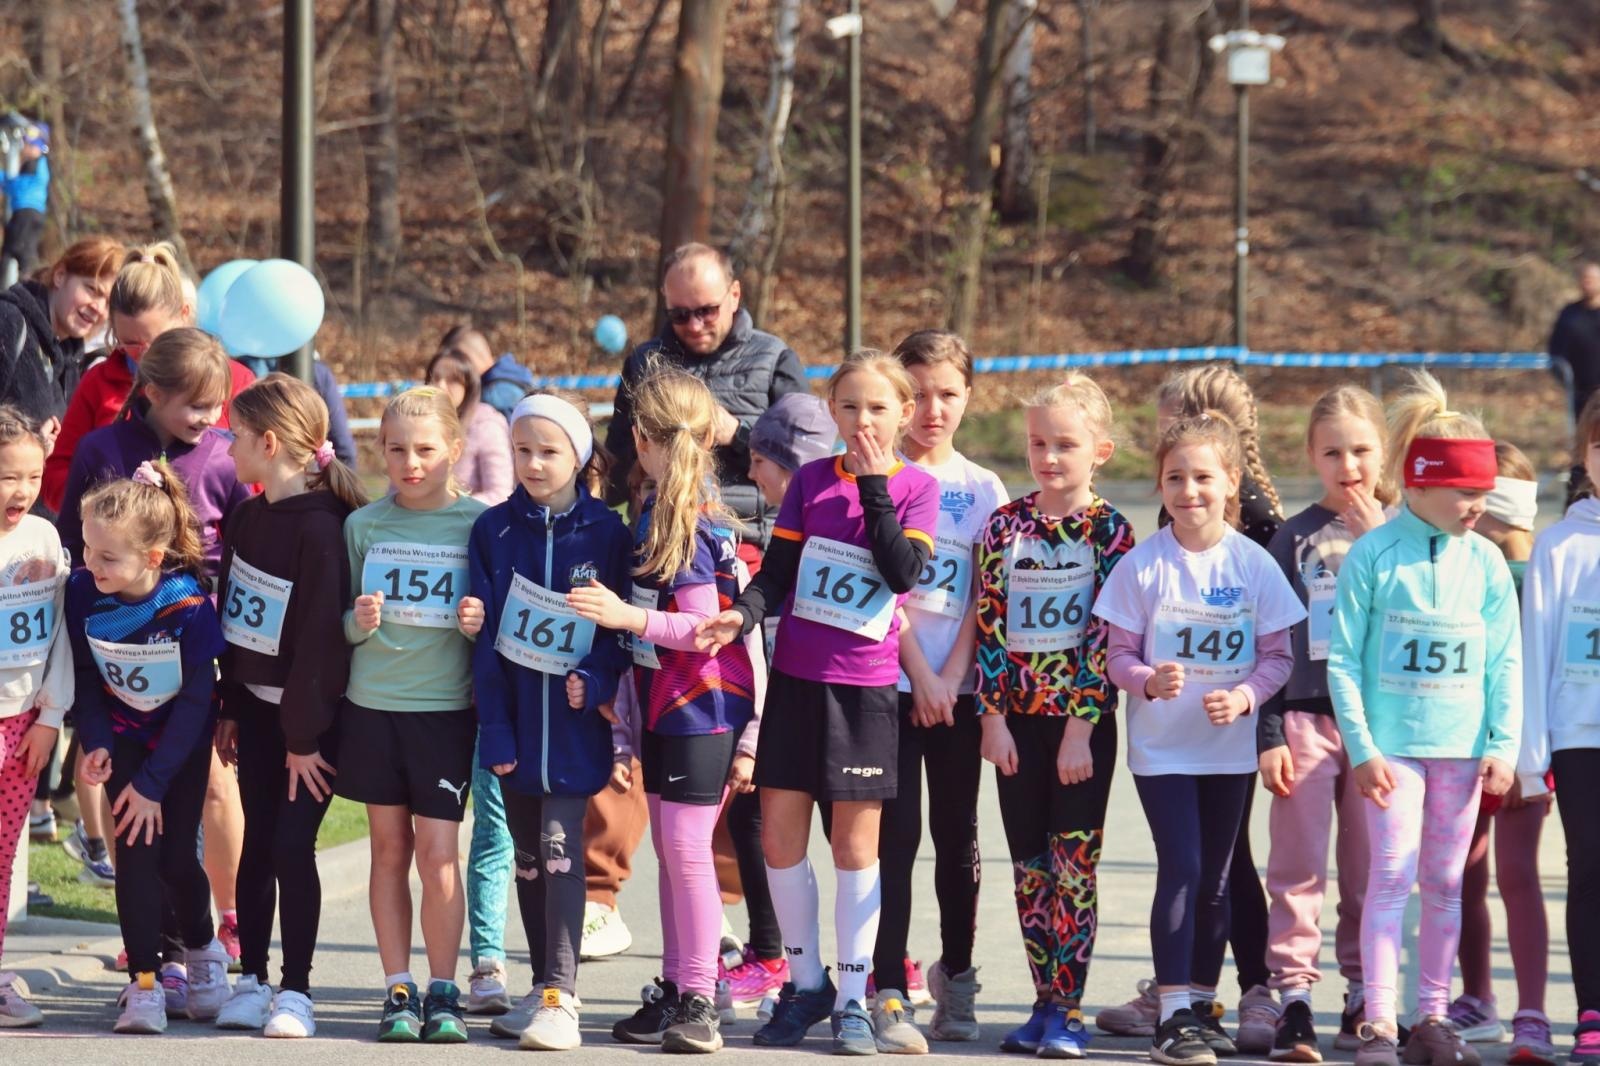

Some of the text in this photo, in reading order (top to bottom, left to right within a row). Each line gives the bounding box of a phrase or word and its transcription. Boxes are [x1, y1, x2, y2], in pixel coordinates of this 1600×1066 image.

[381, 547, 411, 556] Błękitna
[412, 549, 440, 559] Wstęga
[384, 568, 454, 605] 154
[812, 566, 882, 609] 167
[1200, 587, 1242, 597] UKS
[10, 607, 48, 645] 81
[1020, 593, 1083, 629] 166
[513, 608, 577, 653] 161
[1176, 627, 1244, 661] 149
[1403, 639, 1468, 673] 151
[105, 662, 149, 692] 86
[842, 766, 883, 777] regio
